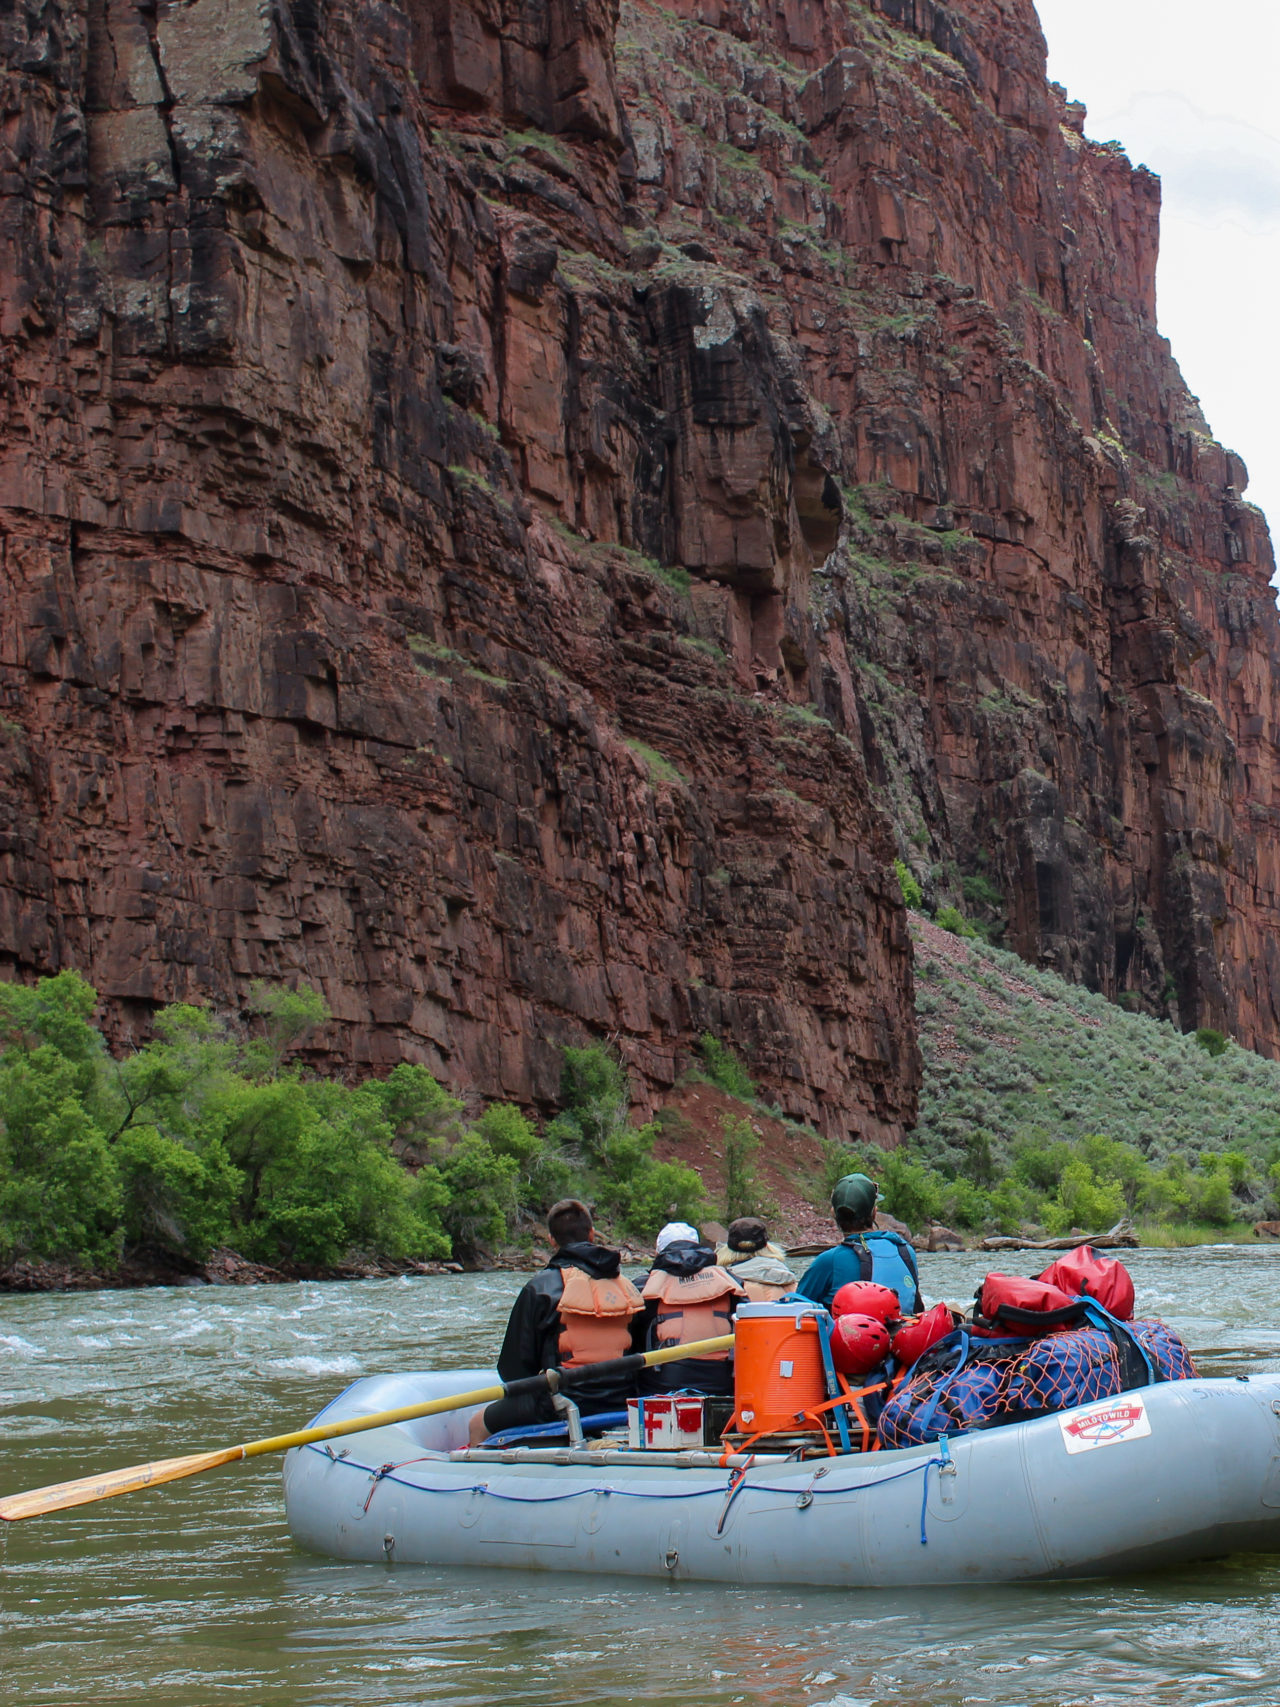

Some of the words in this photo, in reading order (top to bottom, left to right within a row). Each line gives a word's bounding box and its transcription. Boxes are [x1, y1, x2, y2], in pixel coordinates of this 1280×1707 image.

[1077, 1417, 1097, 1430] MILD
[1098, 1414, 1108, 1423] TO
[1108, 1410, 1130, 1420] WILD
